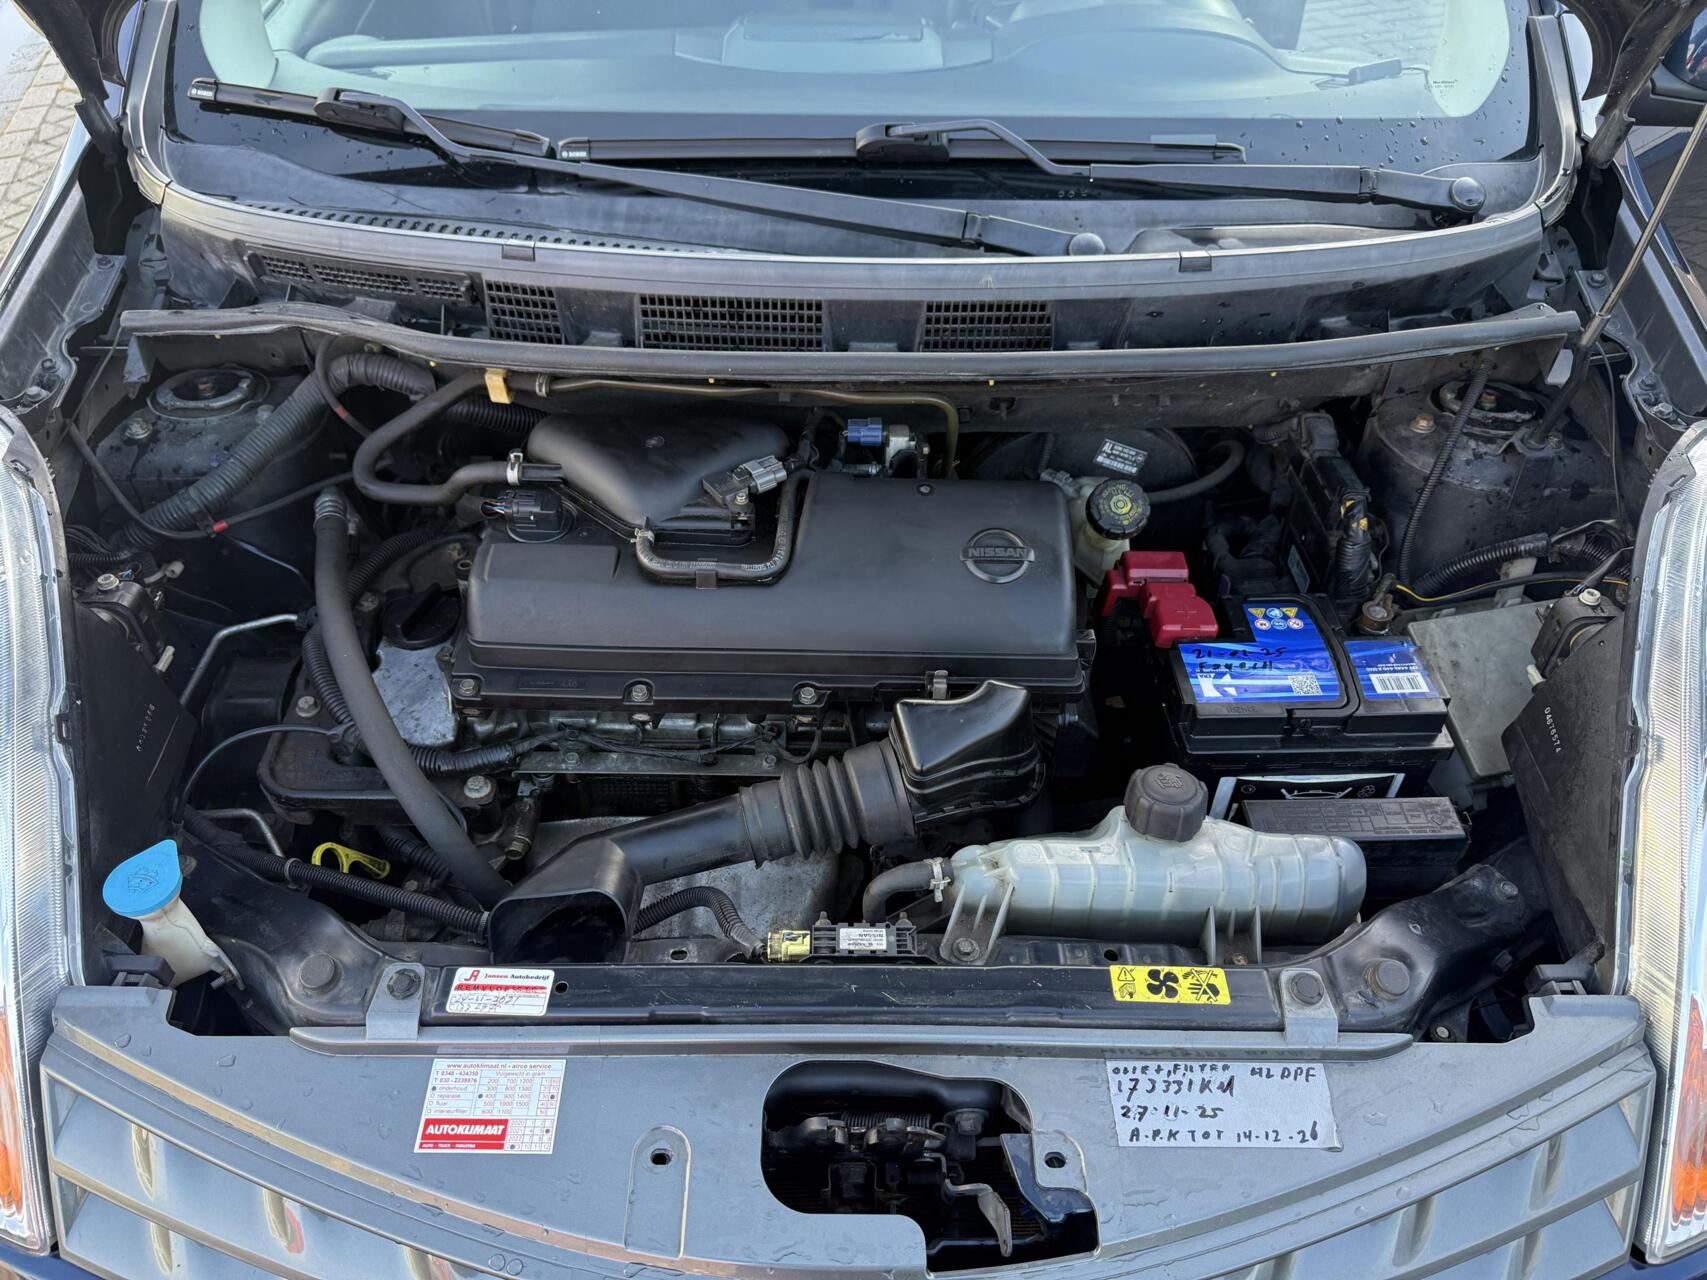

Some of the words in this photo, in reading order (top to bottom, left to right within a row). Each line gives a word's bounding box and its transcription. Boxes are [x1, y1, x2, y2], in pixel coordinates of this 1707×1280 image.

[968, 547, 1027, 558] NISSAN
[1280, 1066, 1316, 1082] DPF
[426, 1124, 505, 1135] AUTOKLIMAAT
[1187, 1130, 1224, 1142] TOT
